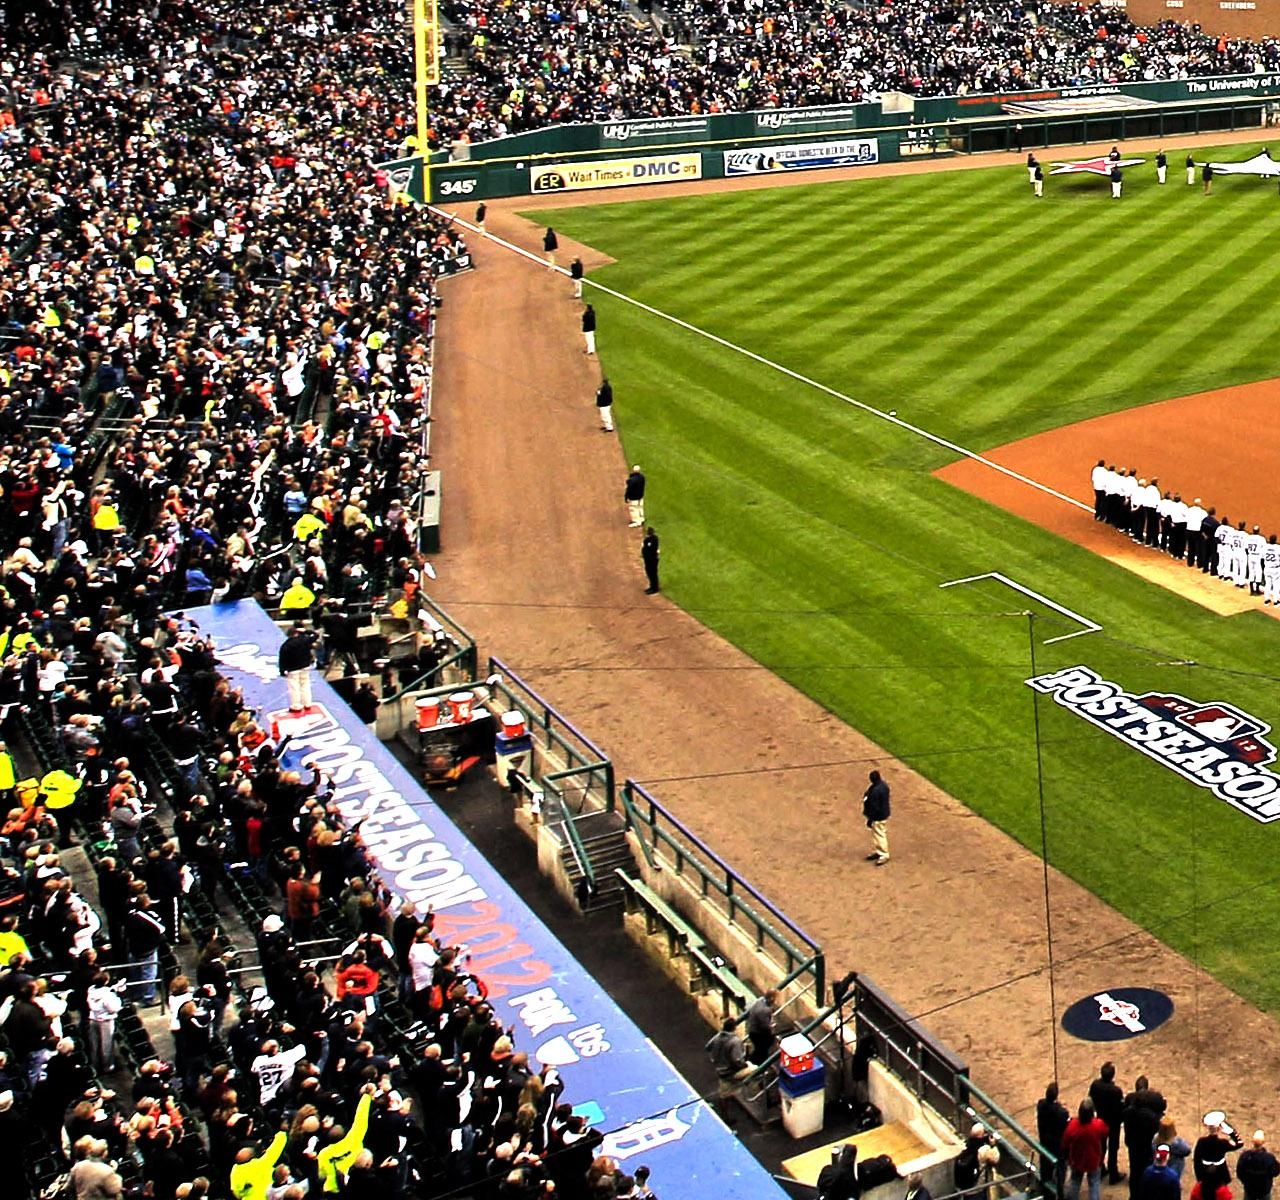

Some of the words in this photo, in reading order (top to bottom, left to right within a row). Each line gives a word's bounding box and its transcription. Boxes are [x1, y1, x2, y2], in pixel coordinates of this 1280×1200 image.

[1186, 81, 1207, 93] The
[1208, 79, 1259, 91] University
[1261, 77, 1273, 87] of
[539, 175, 560, 189] ER
[568, 171, 593, 182] Wait
[594, 170, 623, 181] Times
[632, 161, 681, 177] DMC
[440, 179, 477, 196] 345'
[291, 725, 488, 915] POSTSEASON
[430, 899, 552, 999] 2012
[261, 1069, 283, 1086] 27
